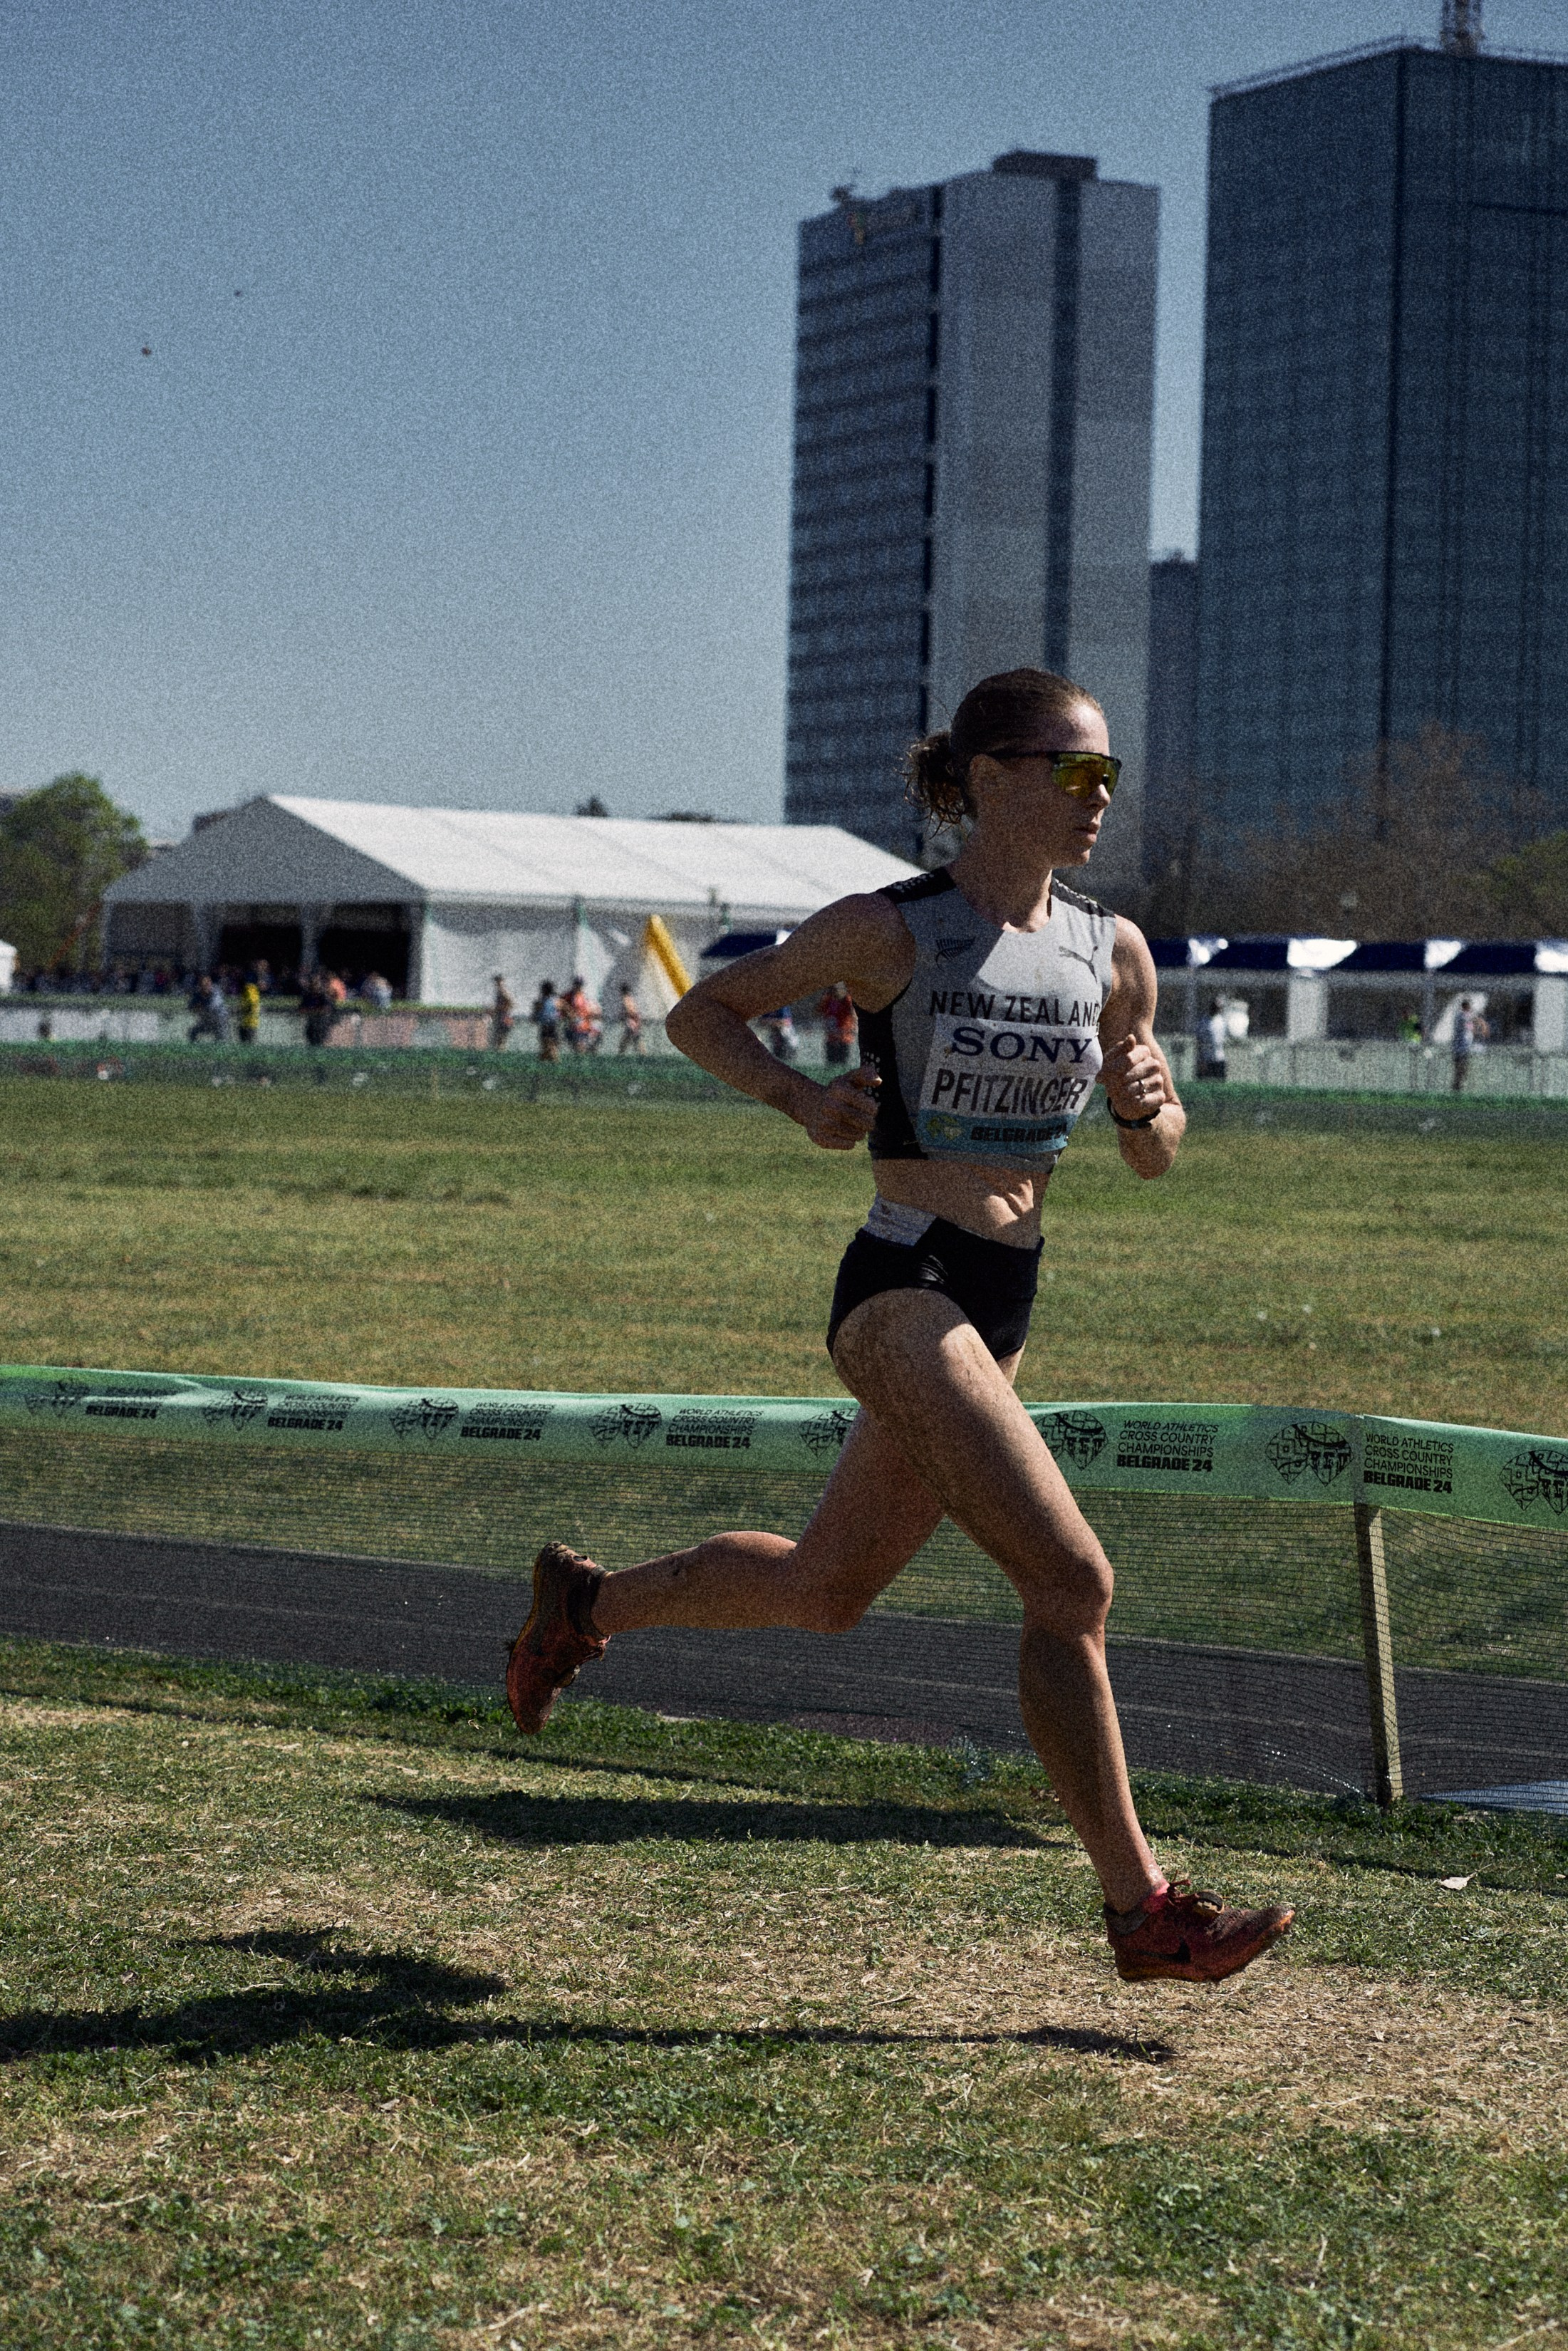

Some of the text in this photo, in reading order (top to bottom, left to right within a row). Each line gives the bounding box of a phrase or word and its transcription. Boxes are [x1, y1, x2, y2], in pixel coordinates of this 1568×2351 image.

[929, 991, 996, 1019] NEW
[951, 1027, 1093, 1064] SONY
[931, 1068, 1088, 1114] PFITZINGER
[85, 1405, 158, 1419] BELGRADE 24
[708, 1416, 758, 1424] COUNTRY
[267, 1417, 343, 1431] BELGRADE 24
[668, 1423, 754, 1436] CHAMPIONSHIPS
[1124, 1420, 1220, 1433] WORLD ATHLETICS
[460, 1426, 541, 1441] BELGRADE 24
[666, 1434, 751, 1448] BELGRADE 24
[1119, 1430, 1216, 1445] CROSS COUNTRY
[1118, 1442, 1213, 1458] CHAMPIONSHIPS
[1366, 1433, 1454, 1453] WORLD ATHLETICS
[1365, 1445, 1453, 1465] CROSS COUNTRY
[1116, 1454, 1213, 1473] BELGRADE 24
[1364, 1458, 1453, 1479] CHAMPIONSHIPS
[1364, 1470, 1453, 1494] BELGRADE 24
